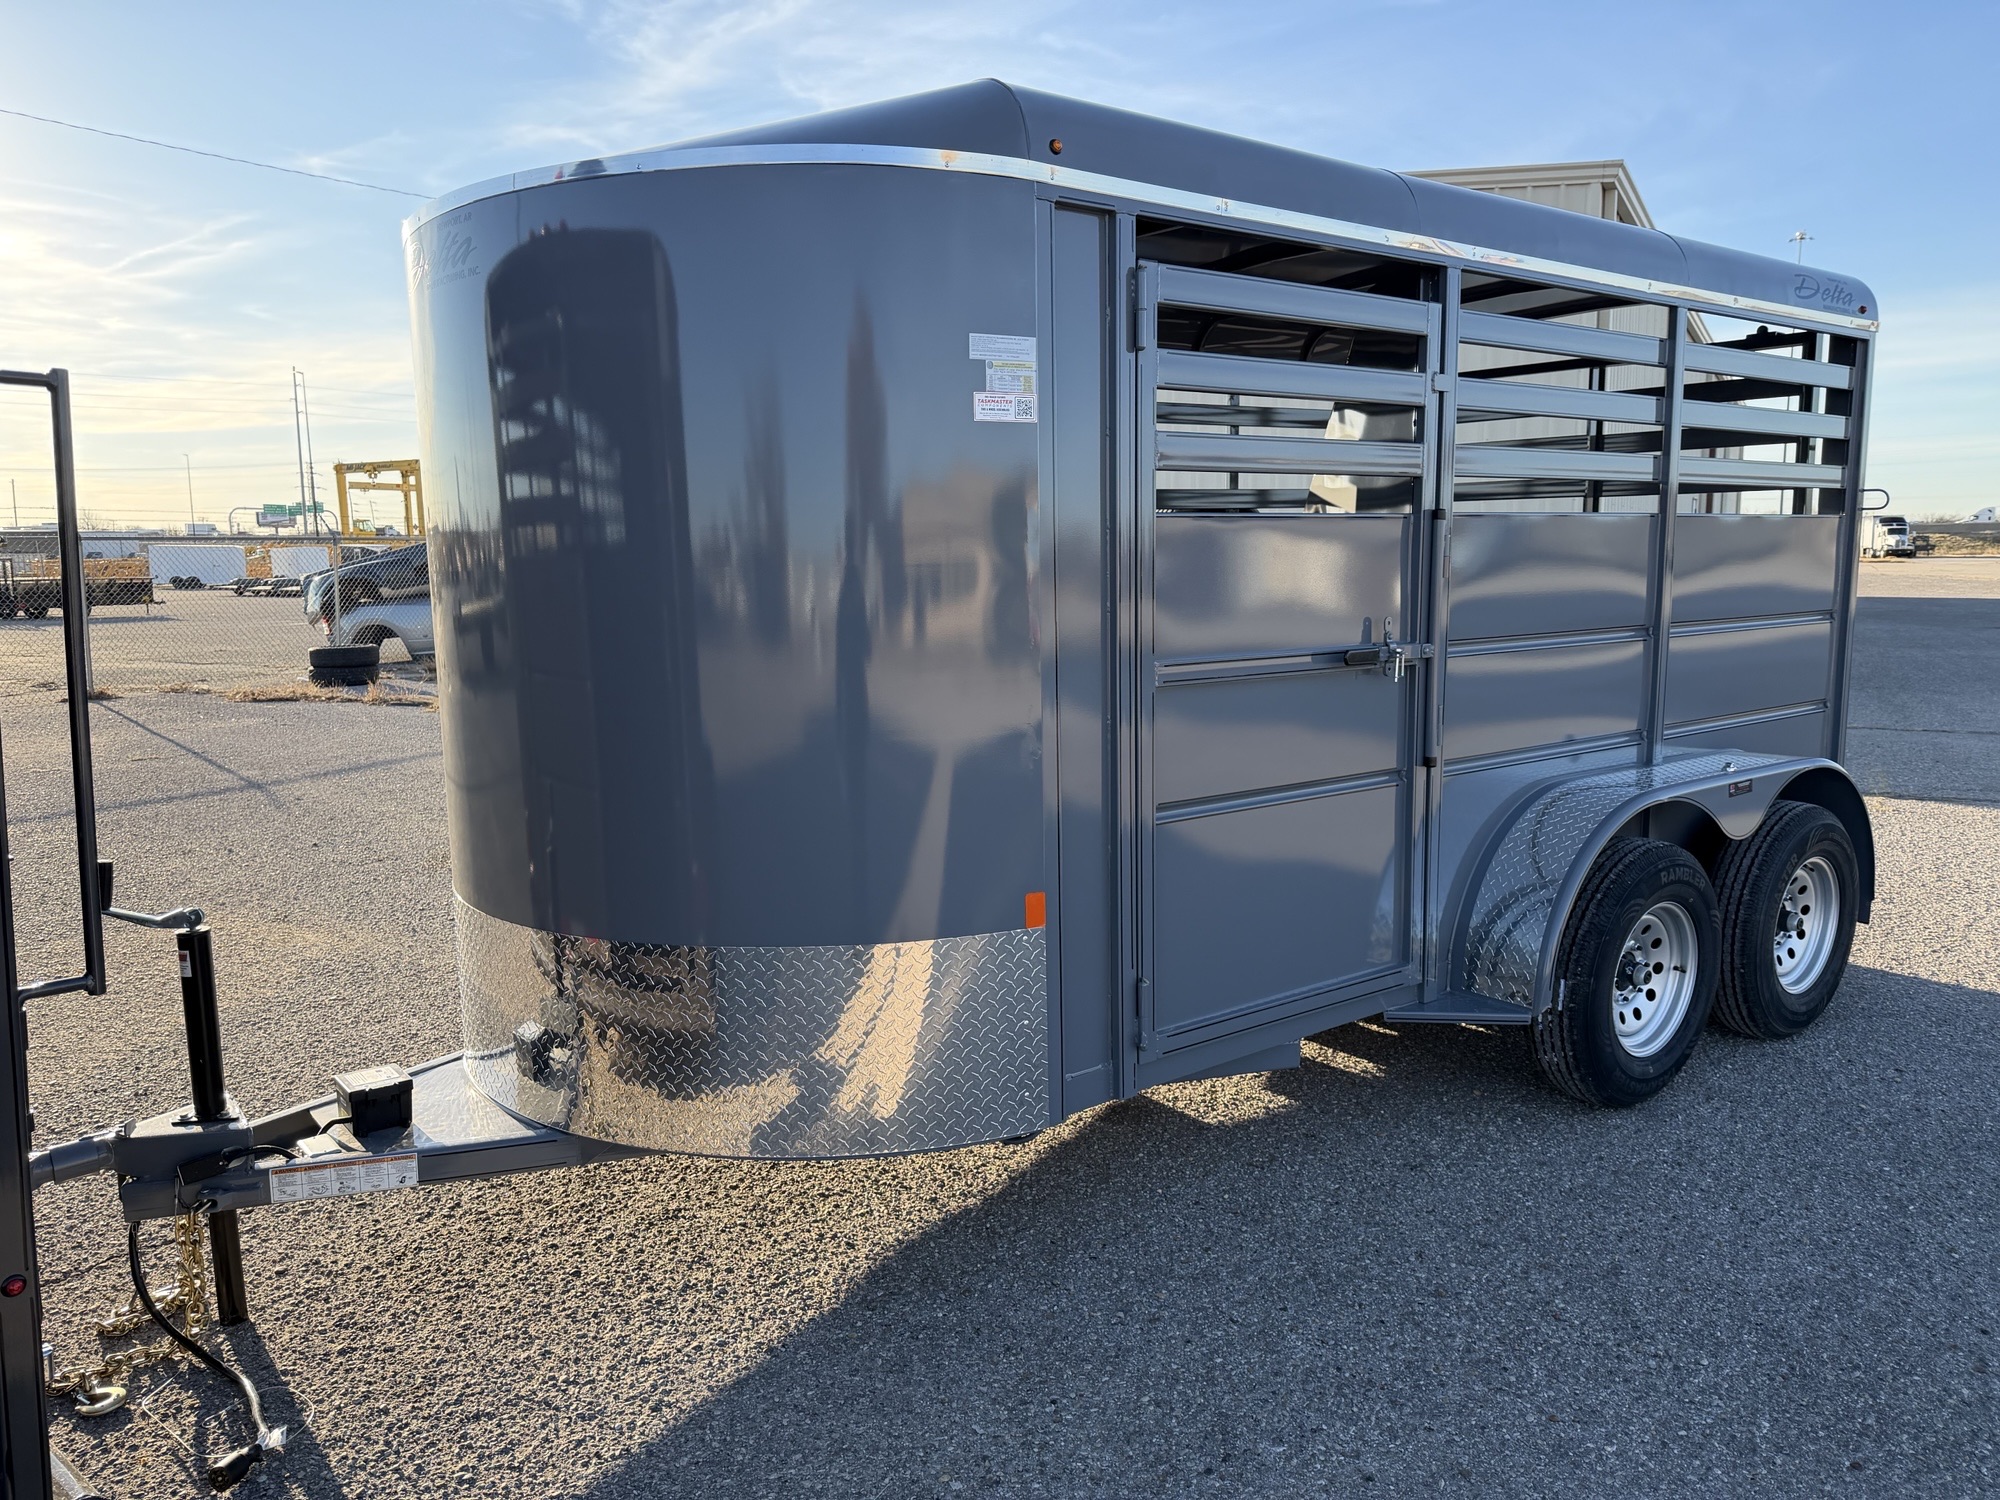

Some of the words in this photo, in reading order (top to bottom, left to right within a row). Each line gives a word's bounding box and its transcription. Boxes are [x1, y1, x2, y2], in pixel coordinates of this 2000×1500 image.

[464, 211, 472, 222] AR
[408, 231, 478, 297] Delta
[467, 266, 481, 277] INC.
[1794, 273, 1857, 307] Delta
[1660, 867, 1706, 891] RAMBLER
